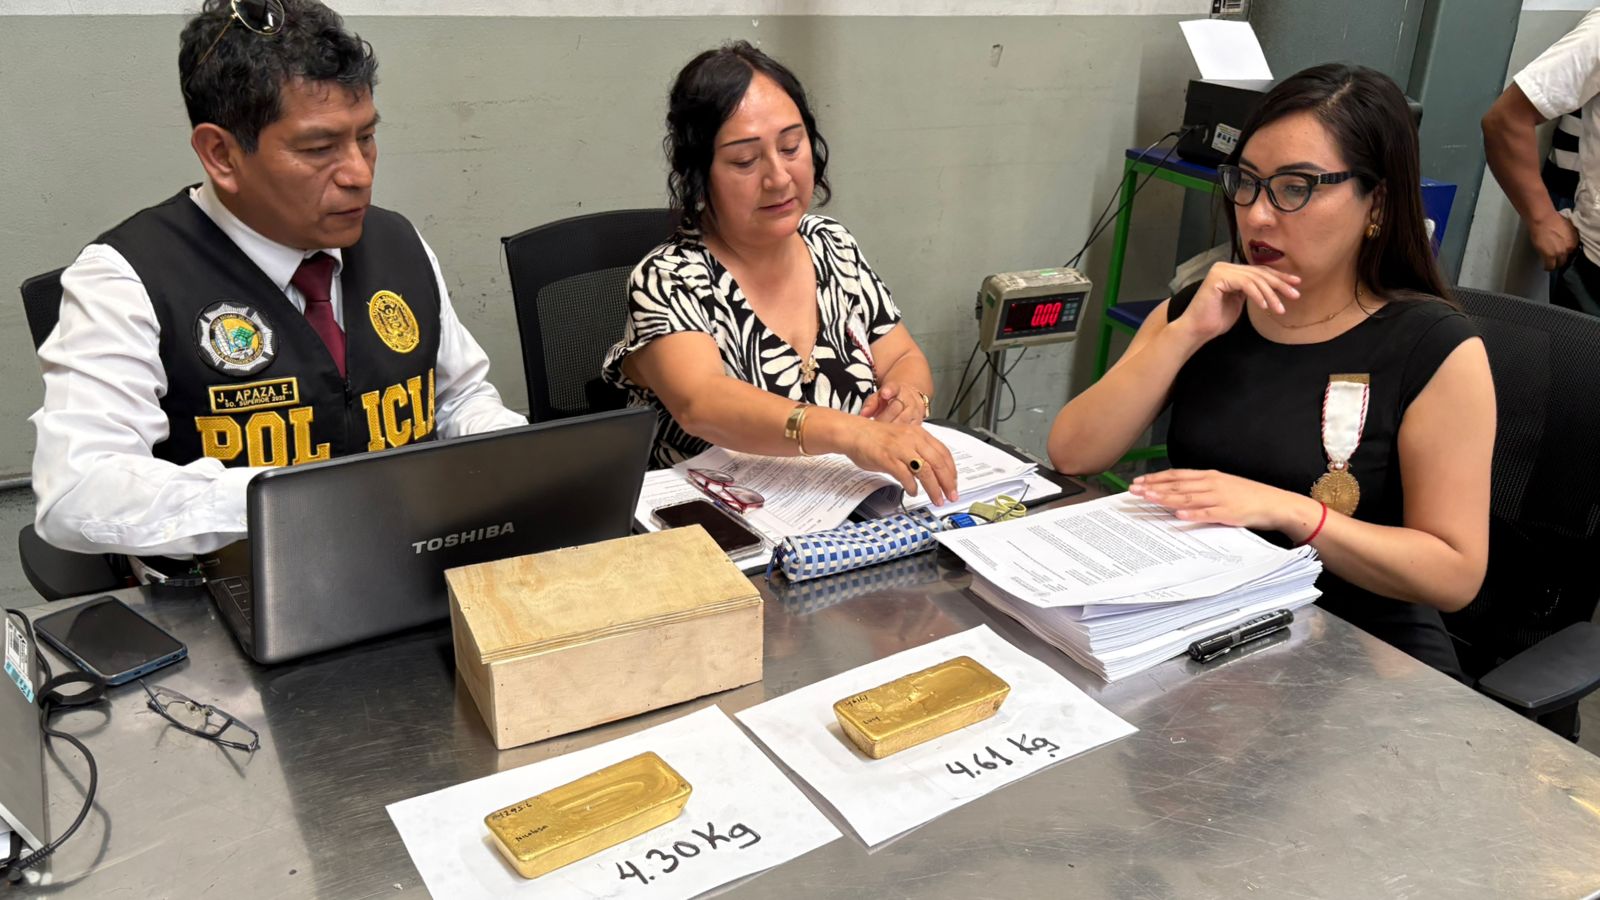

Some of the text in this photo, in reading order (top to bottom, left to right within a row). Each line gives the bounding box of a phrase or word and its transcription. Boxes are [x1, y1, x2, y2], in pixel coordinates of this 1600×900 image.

[217, 383, 293, 404] J. APAZA E.
[411, 522, 515, 554] TOSHIBA
[945, 746, 1013, 779] 4.61
